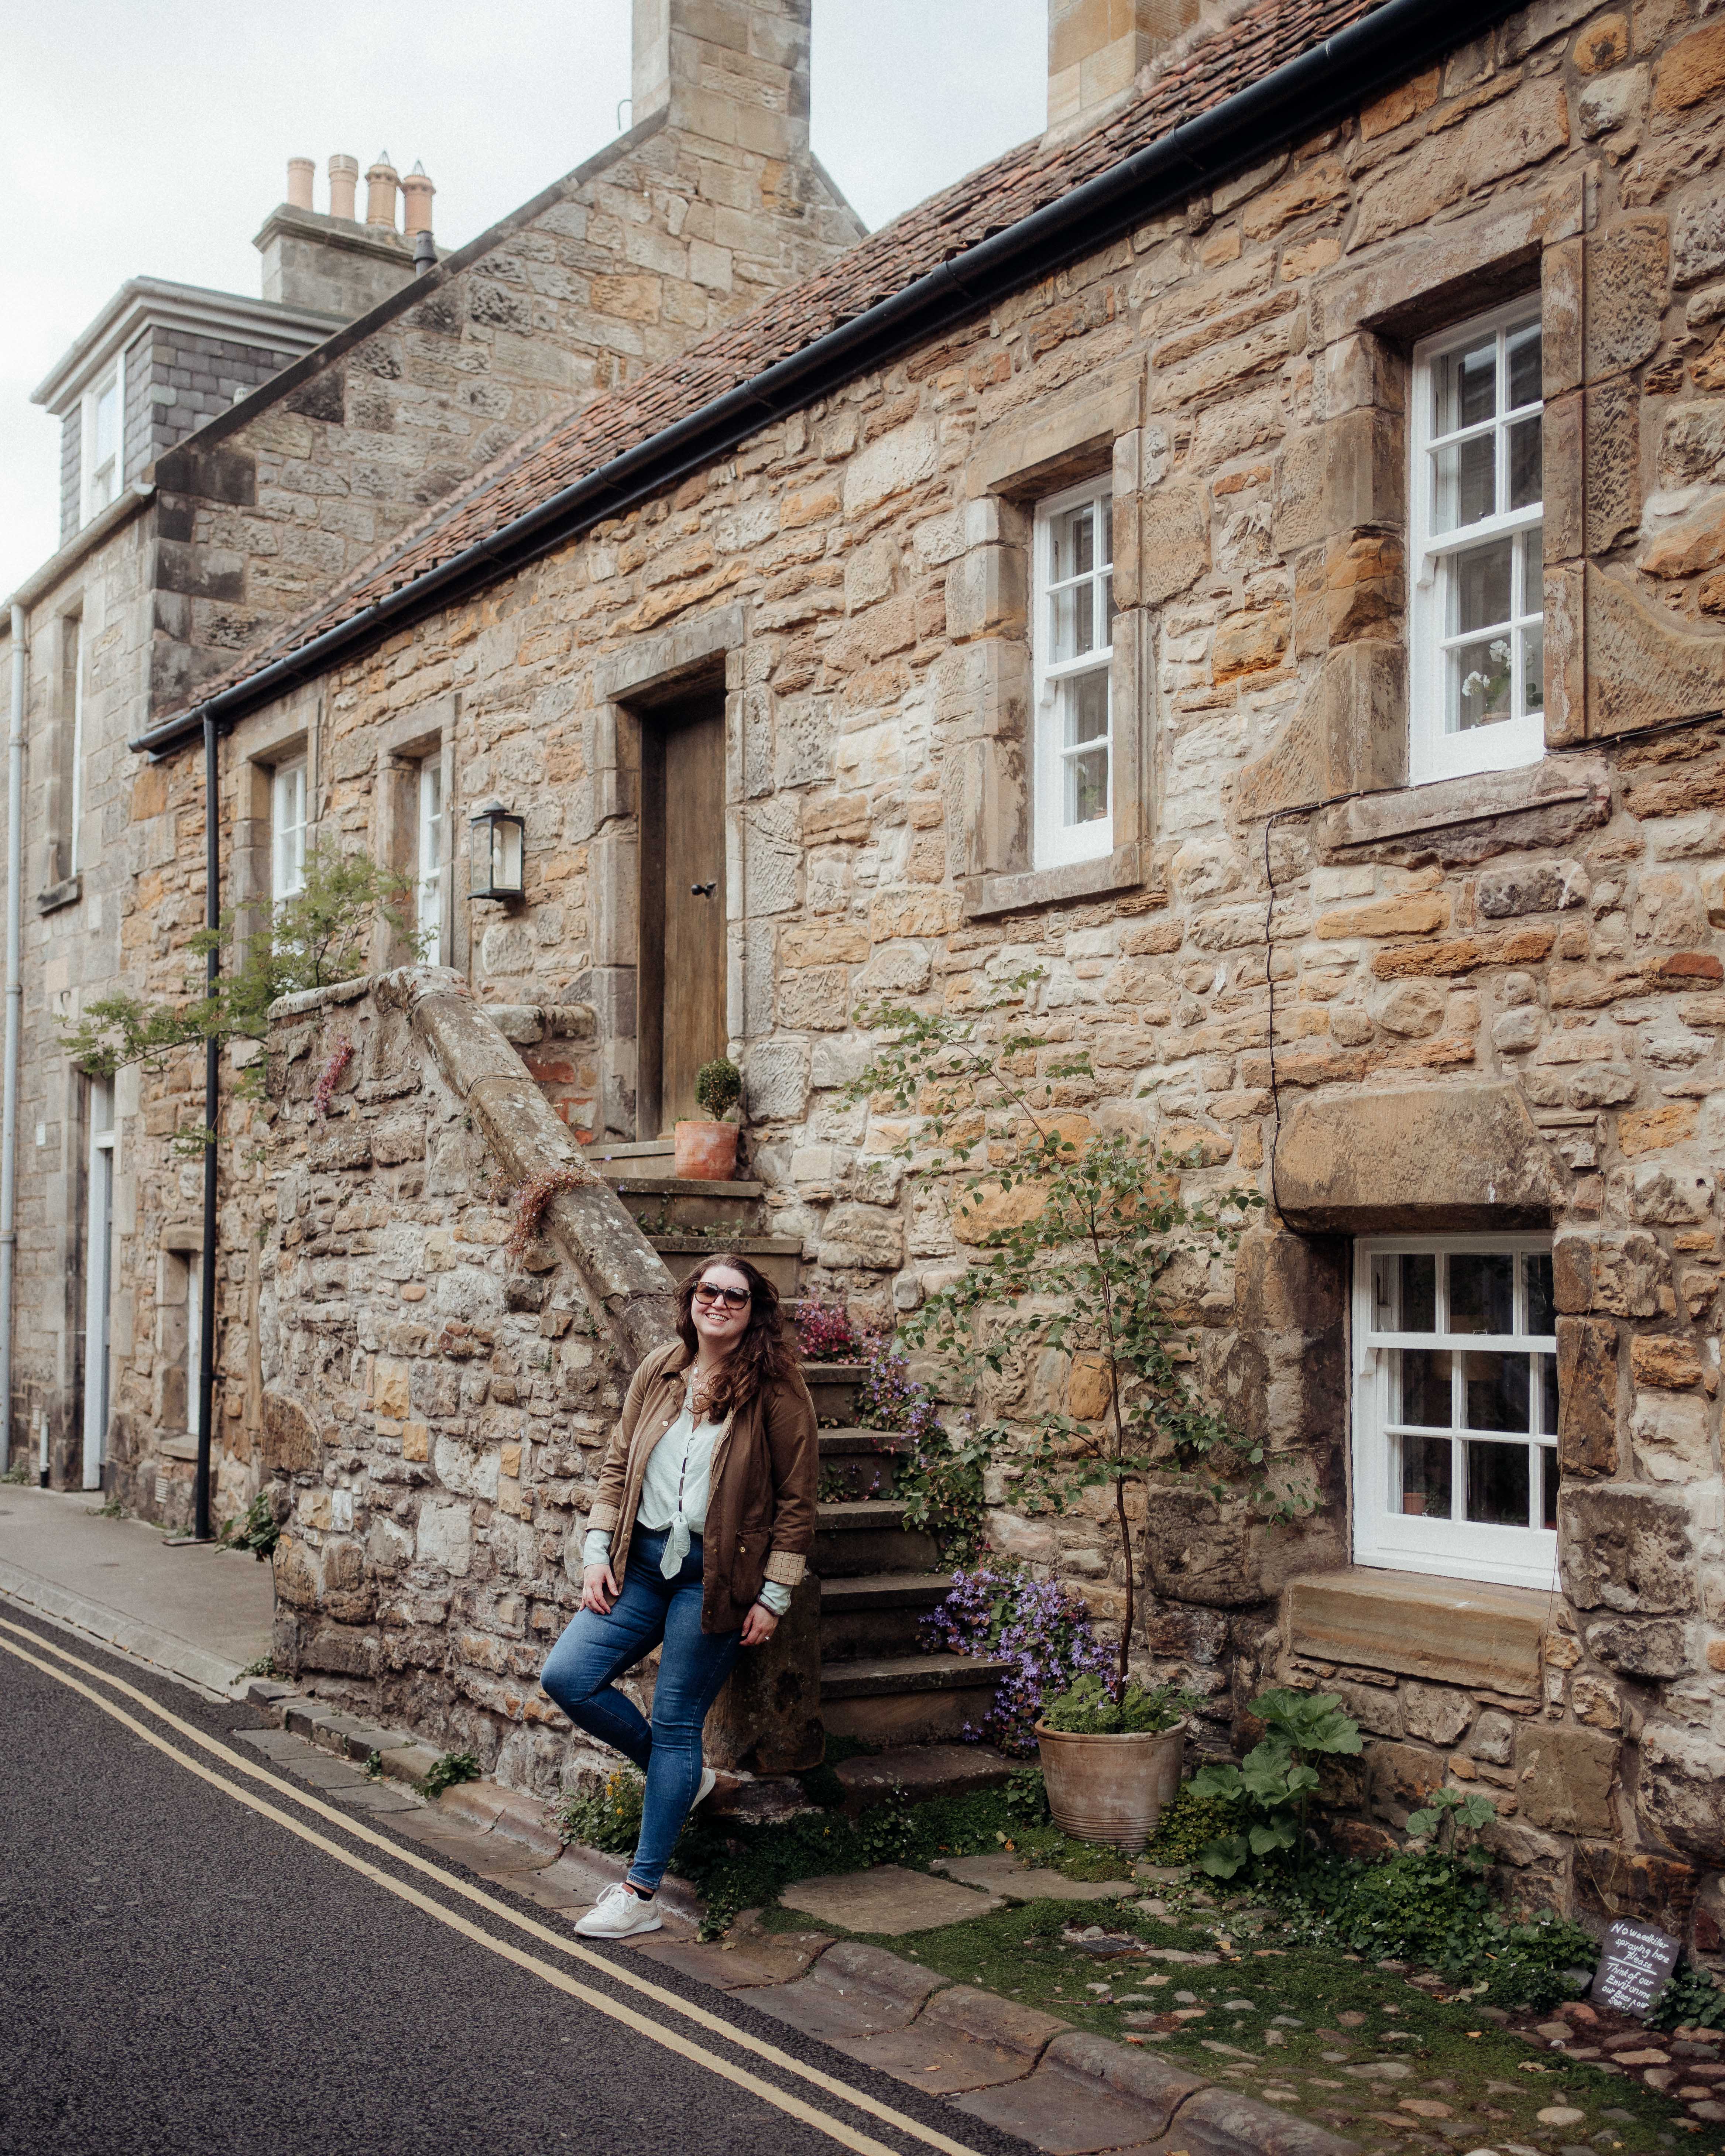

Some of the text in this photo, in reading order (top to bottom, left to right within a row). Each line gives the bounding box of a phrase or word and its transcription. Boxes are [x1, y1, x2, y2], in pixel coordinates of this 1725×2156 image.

[1611, 1923, 1669, 1949] No weedkiller
[1615, 1939, 1670, 1964] spraying here
[1605, 1974, 1651, 1999] Environme
[1607, 1962, 1654, 1986] Think of our
[1602, 1986, 1616, 1994] our
[1614, 1990, 1632, 2002] Bees
